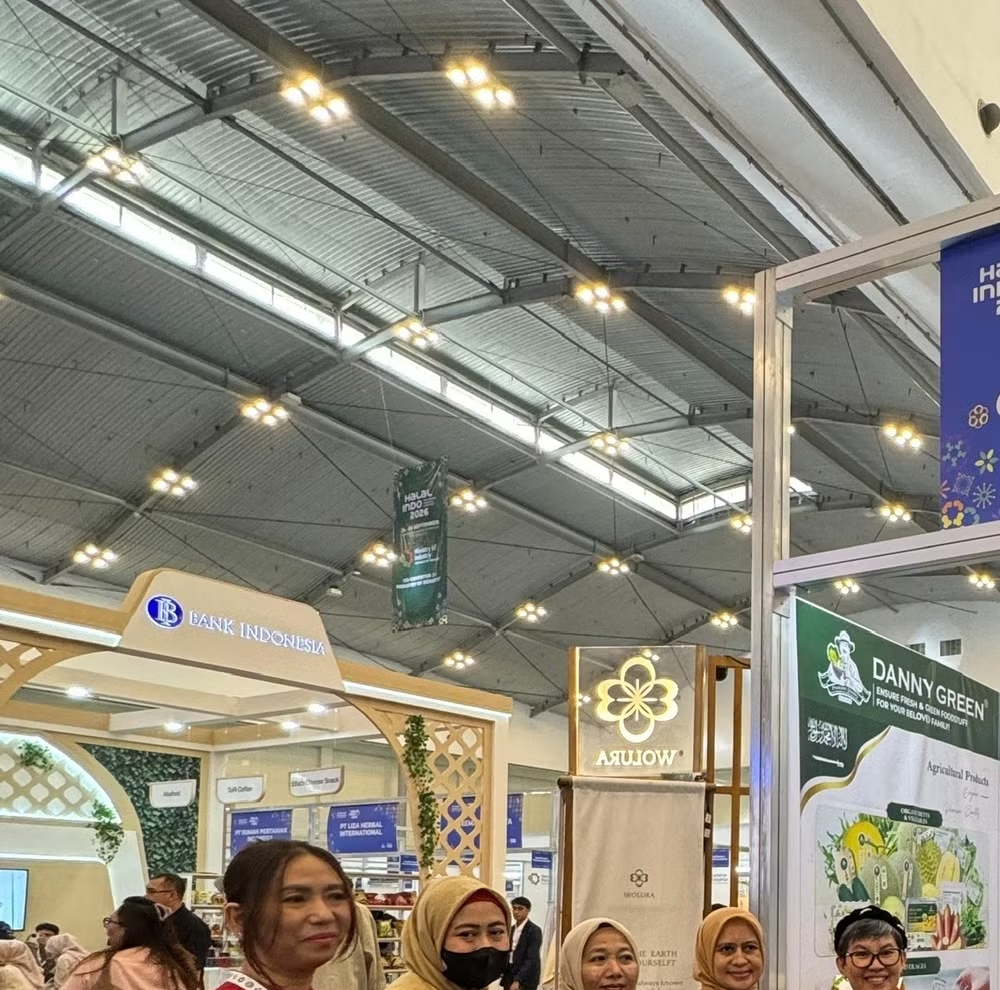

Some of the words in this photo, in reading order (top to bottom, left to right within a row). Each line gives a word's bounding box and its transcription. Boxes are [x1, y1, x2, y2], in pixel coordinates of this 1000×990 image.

[409, 507, 429, 520] 2026
[189, 610, 235, 636] BANK
[239, 622, 327, 656] INDONESIA
[872, 656, 934, 699] DANNY
[935, 684, 986, 721] GREEN
[876, 685, 900, 703] ENSURE
[876, 697, 890, 711] FOR
[889, 702, 905, 715] YOUR
[927, 760, 964, 782] Agricultural
[623, 891, 655, 899] WOLURA
[650, 950, 678, 958] EARTH
